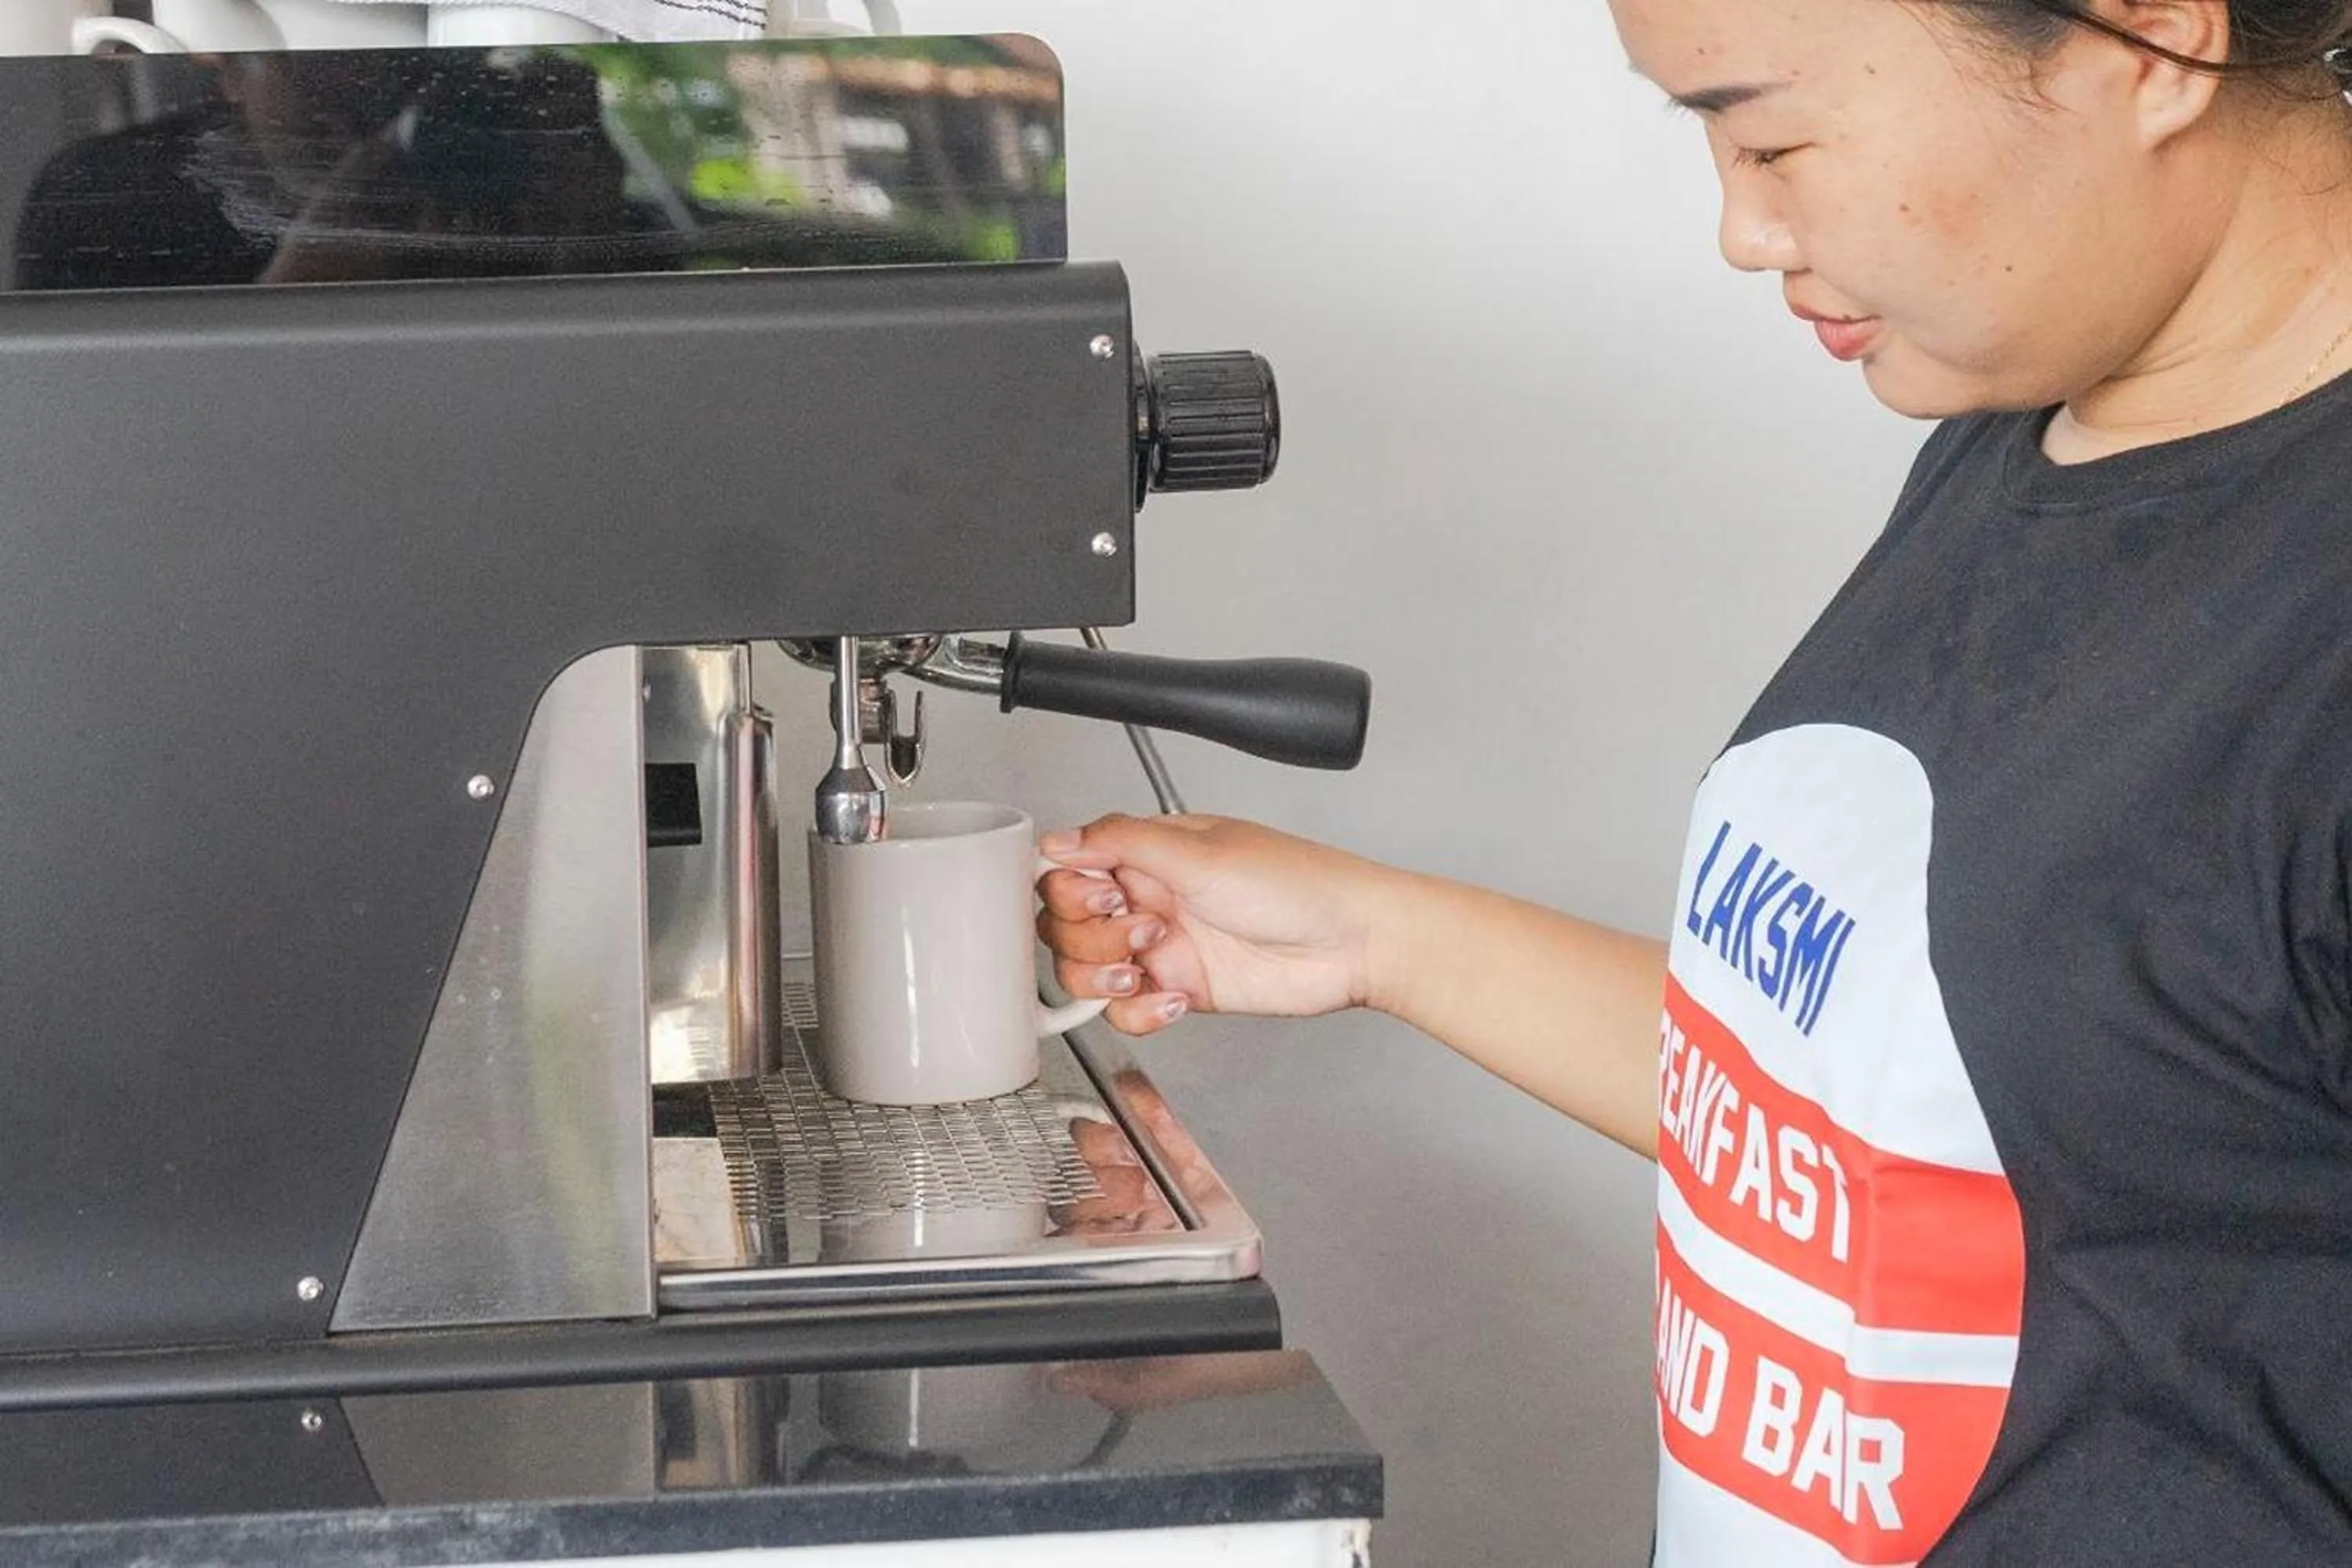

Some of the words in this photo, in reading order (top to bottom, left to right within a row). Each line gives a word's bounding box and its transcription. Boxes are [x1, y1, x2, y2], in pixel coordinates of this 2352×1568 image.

[1687, 821, 1856, 1036] LAKSMI
[1659, 1007, 1850, 1263] REAKFAST
[1657, 1276, 1730, 1438] AND
[1741, 1355, 1904, 1530] BAR
